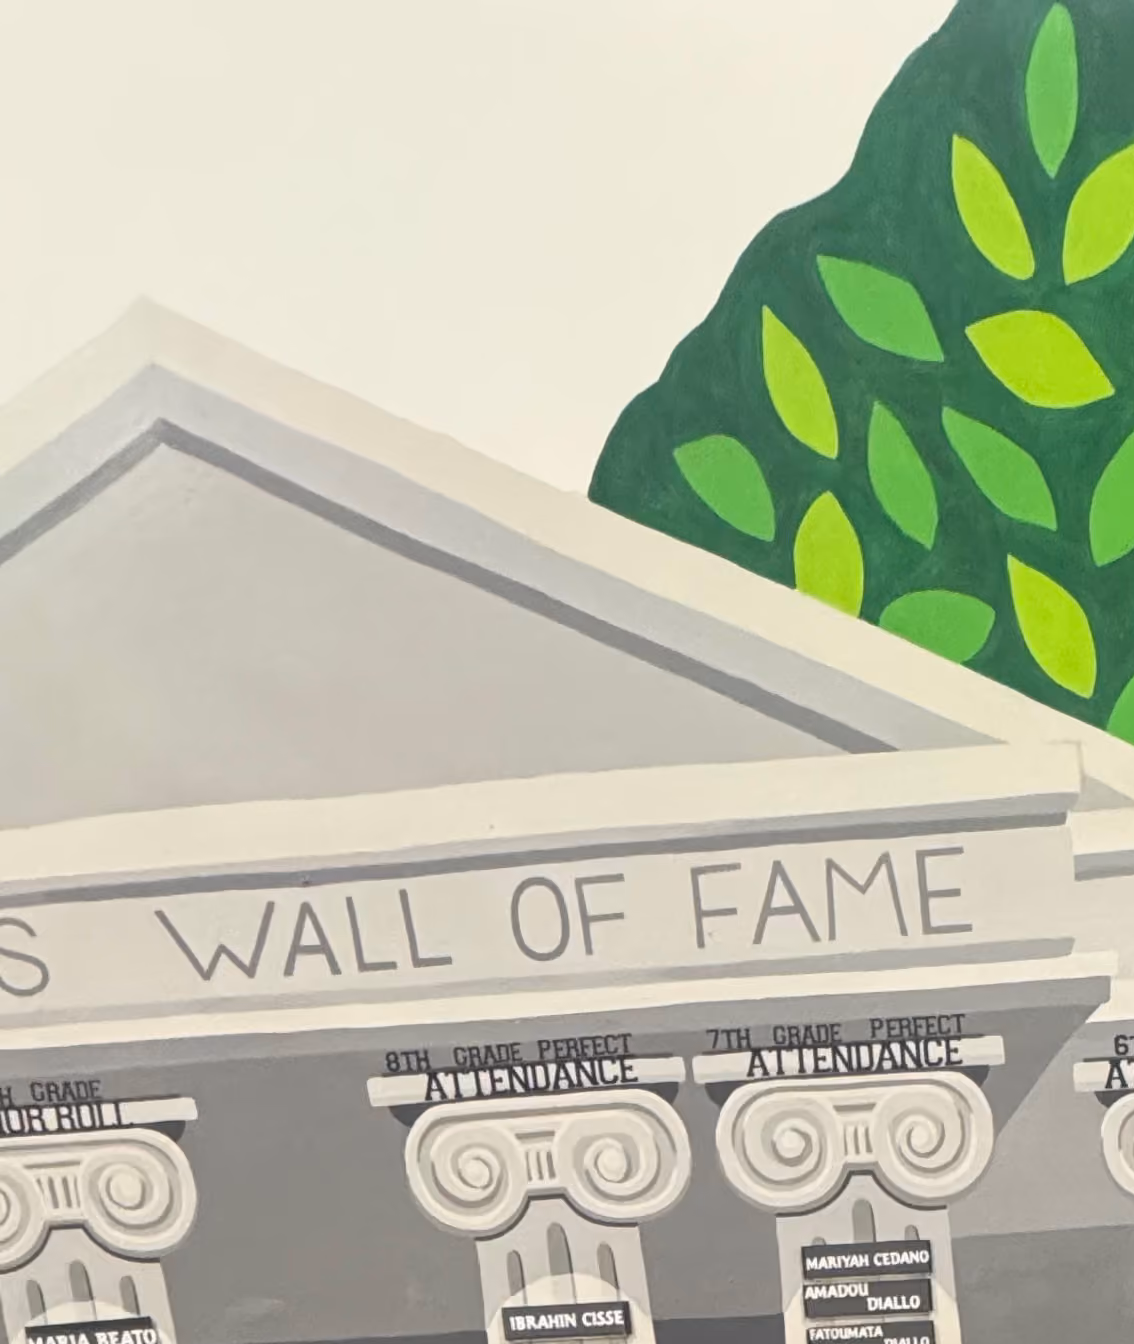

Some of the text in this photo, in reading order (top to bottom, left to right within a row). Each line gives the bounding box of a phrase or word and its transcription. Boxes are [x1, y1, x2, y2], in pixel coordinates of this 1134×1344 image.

[155, 888, 452, 982] WALL
[510, 873, 625, 962] OF
[690, 846, 974, 949] FAME
[706, 1014, 966, 1049] 7TH GRADE PERFECT
[386, 1033, 633, 1072] 8TH GRADE PERFECT
[747, 1038, 964, 1077] ATTENDANCE
[30, 1080, 102, 1103] GRADE
[425, 1058, 639, 1101] ATTENDANCE
[54, 1101, 134, 1132] ROLL
[805, 1250, 930, 1271] MARIYAH CEDANO
[805, 1283, 869, 1299] AMADOU
[867, 1295, 921, 1311] DIALLO
[582, 1310, 625, 1327] CISSE
[809, 1325, 884, 1341] FATOUMATA
